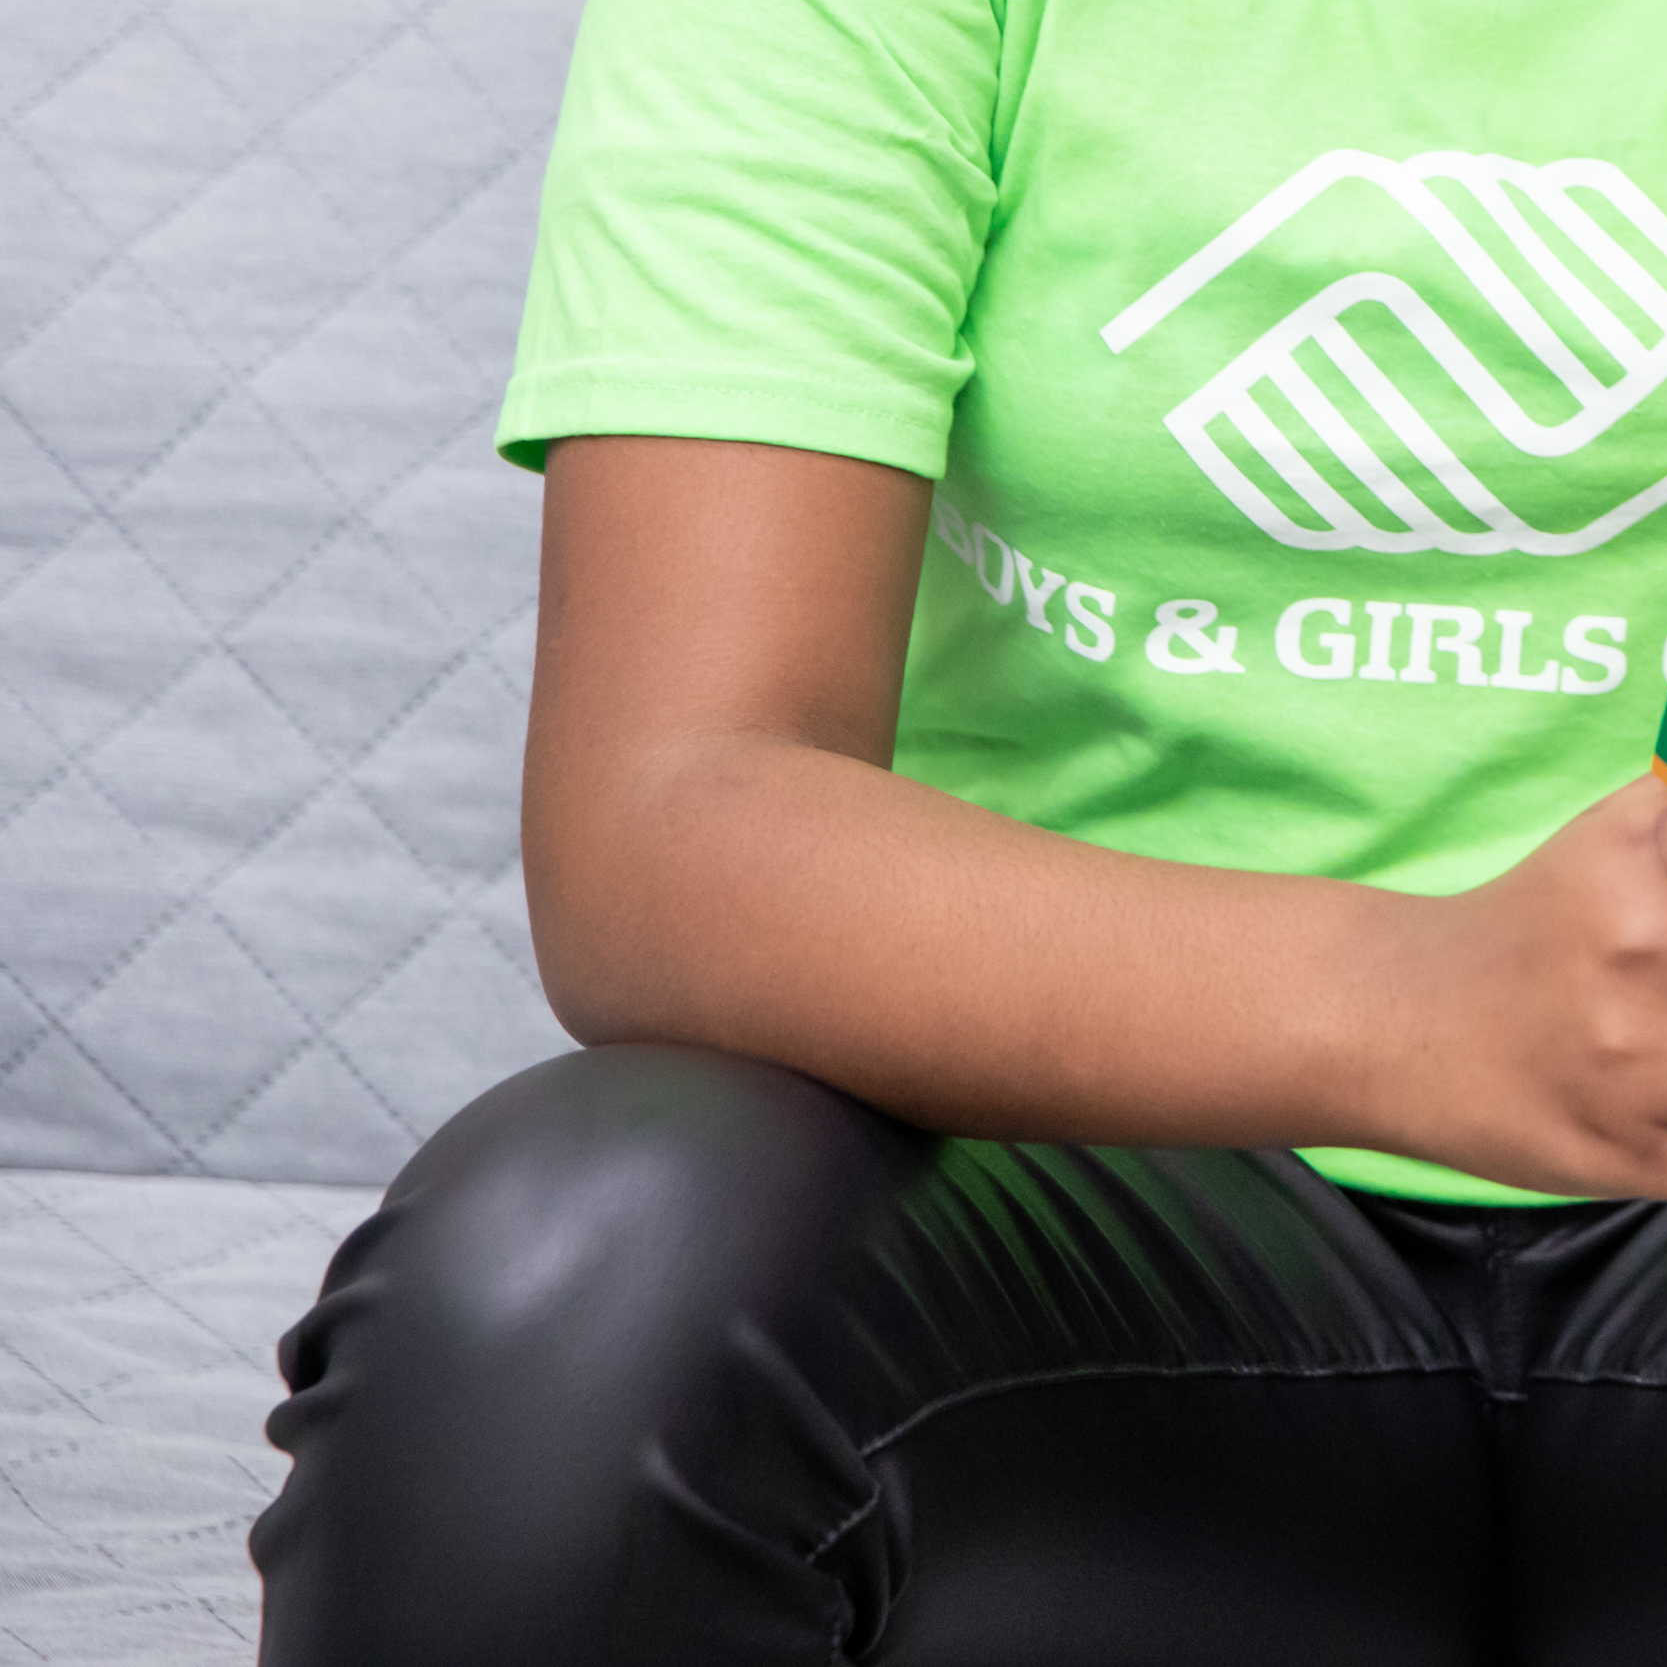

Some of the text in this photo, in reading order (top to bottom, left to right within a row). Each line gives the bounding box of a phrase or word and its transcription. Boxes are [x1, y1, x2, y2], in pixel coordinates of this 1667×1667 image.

[933, 494, 1116, 662] BOYS
[1145, 599, 1246, 675] &
[1274, 597, 1629, 695] GIRLS
